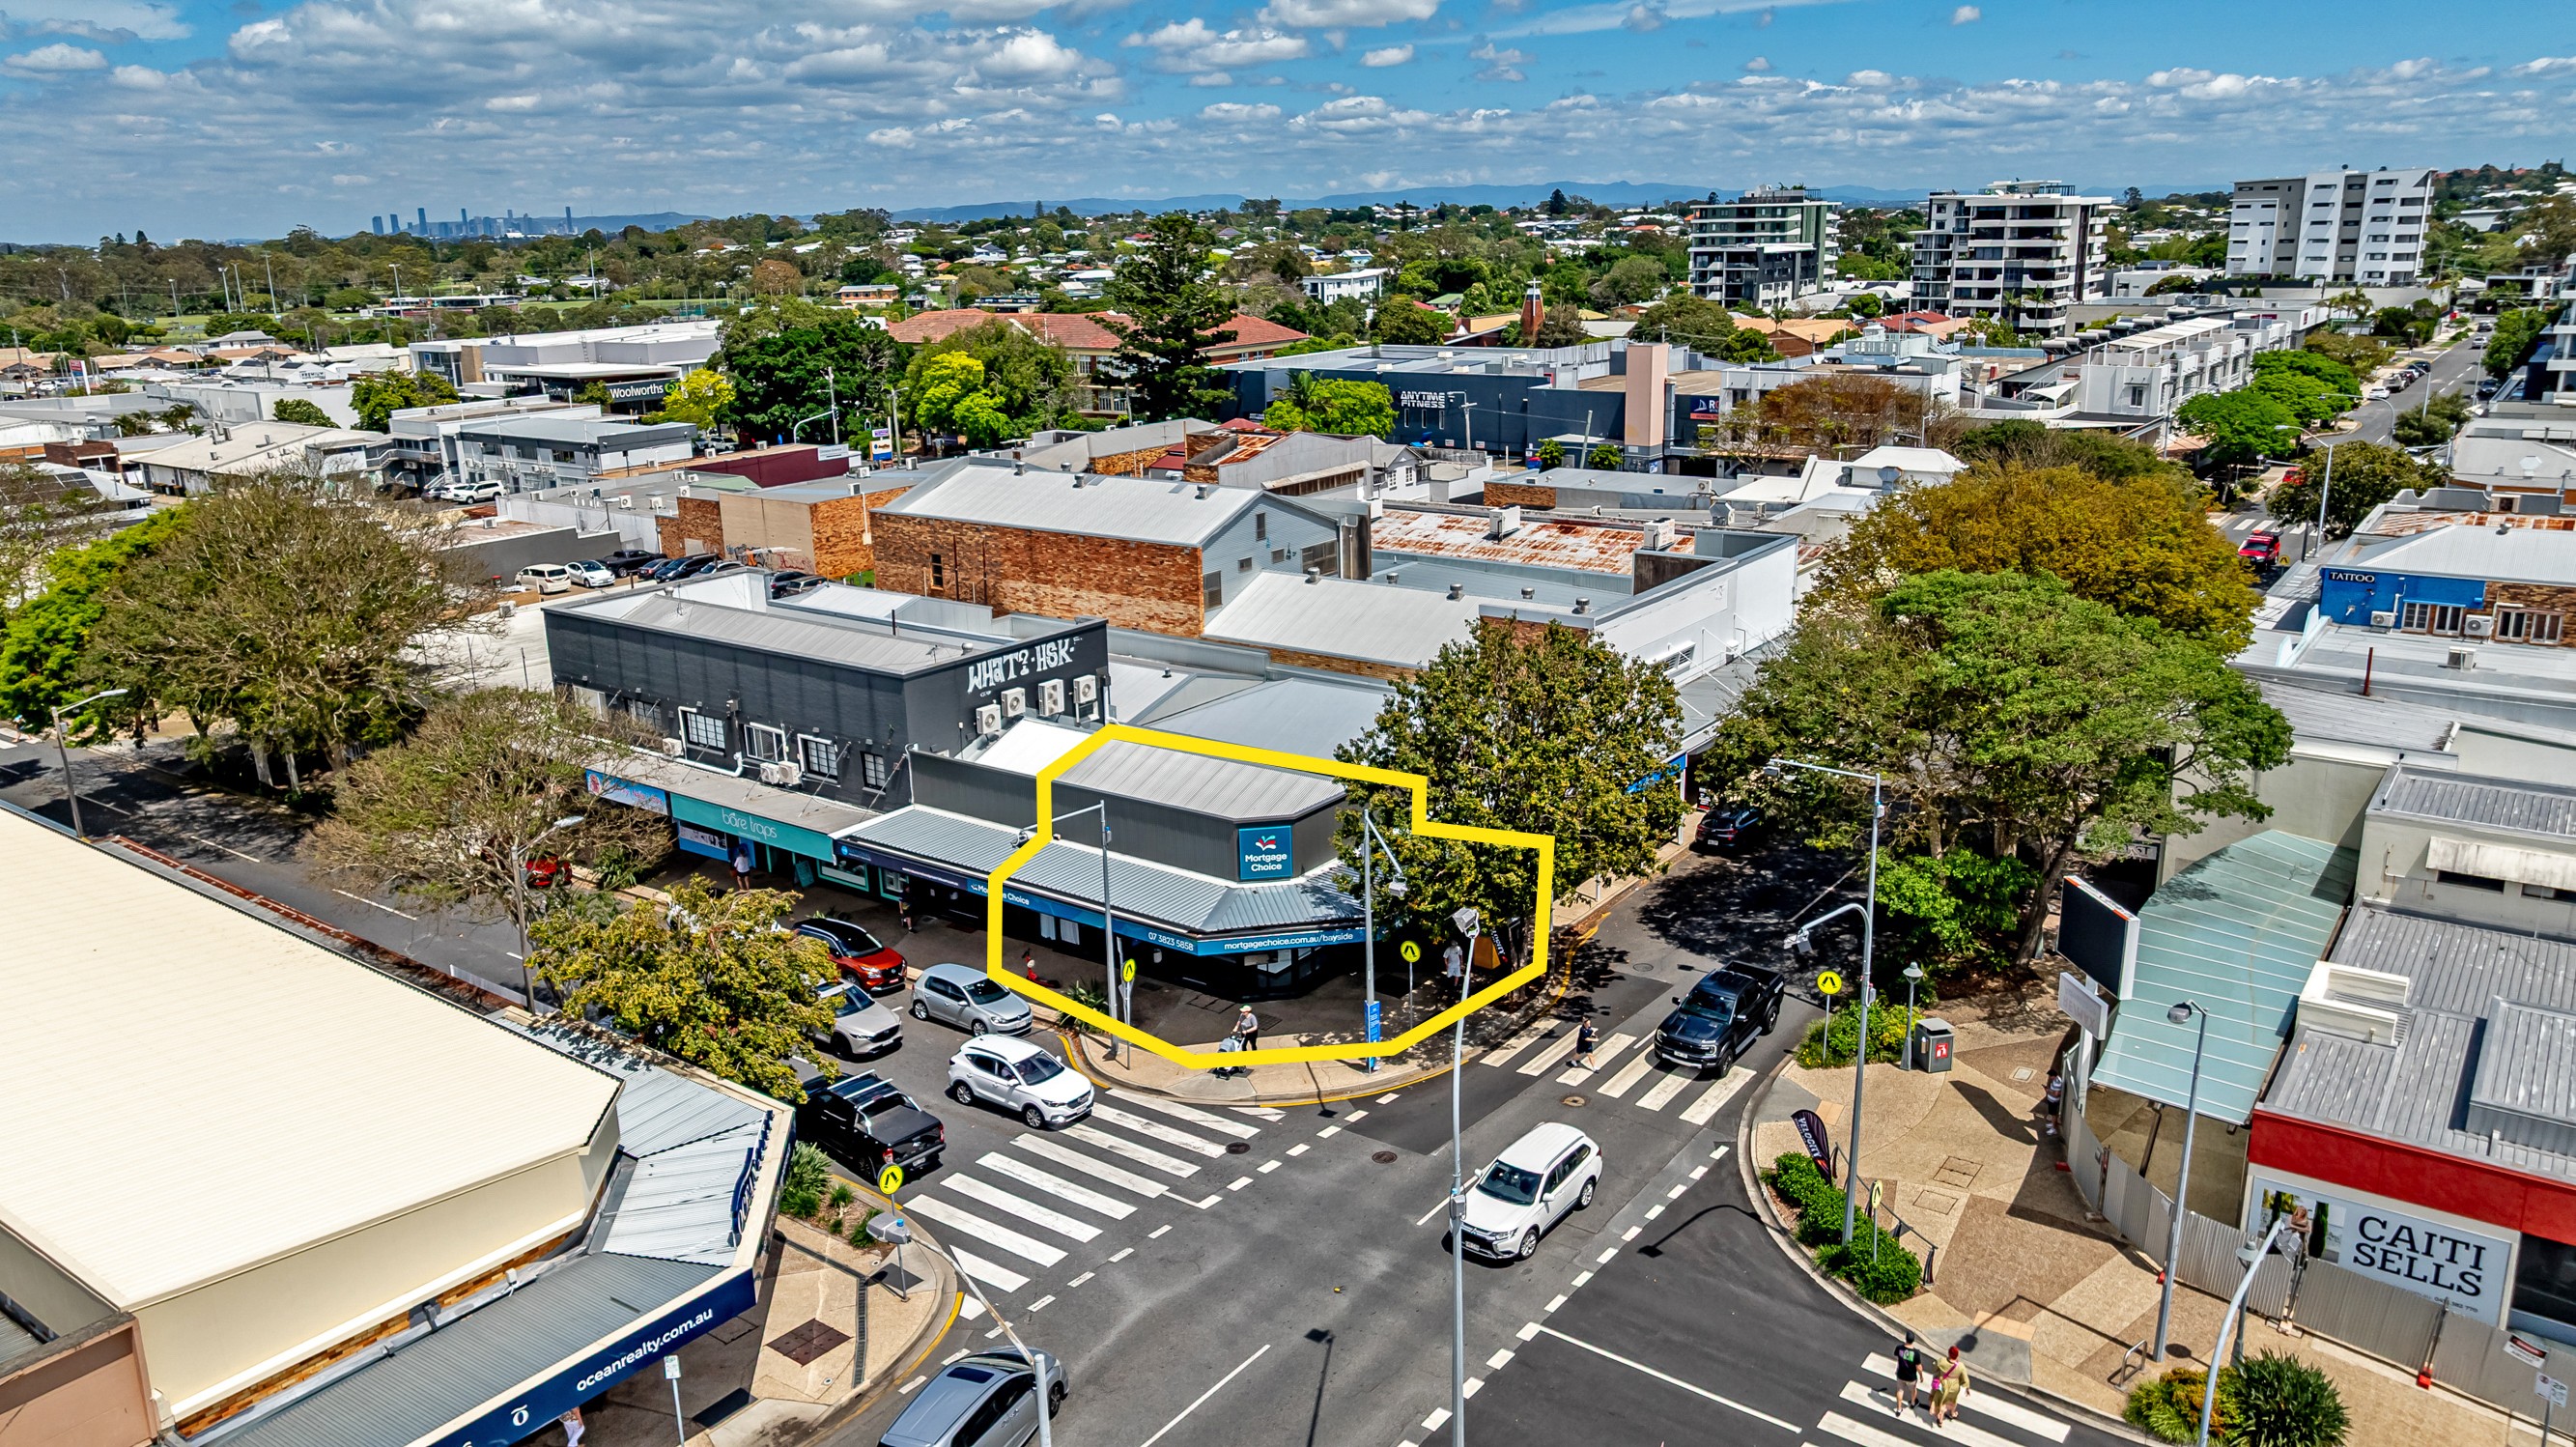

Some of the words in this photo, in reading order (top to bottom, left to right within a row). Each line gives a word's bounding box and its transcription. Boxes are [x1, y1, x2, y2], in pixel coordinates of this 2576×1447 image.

[609, 383, 664, 399] Woolworths
[1401, 390, 1445, 401] ANYTIME
[1401, 399, 1445, 409] FITNESS
[2330, 572, 2375, 583] TATTOO
[750, 815, 778, 840] traps
[1245, 854, 1288, 863] Mortgage
[1251, 863, 1283, 871] Choice
[1007, 893, 1030, 906] Choice
[1147, 931, 1157, 940] 07
[1157, 934, 1175, 947] 3823
[1175, 940, 1194, 951] 5858
[1224, 932, 1354, 950] mortgagechoice.com.au/bayside
[1798, 1117, 1823, 1158] VELOCITY
[2359, 1216, 2485, 1271] CAITI
[2353, 1242, 2481, 1296] SELLS
[577, 1308, 714, 1391] oceanrealty.com.au
